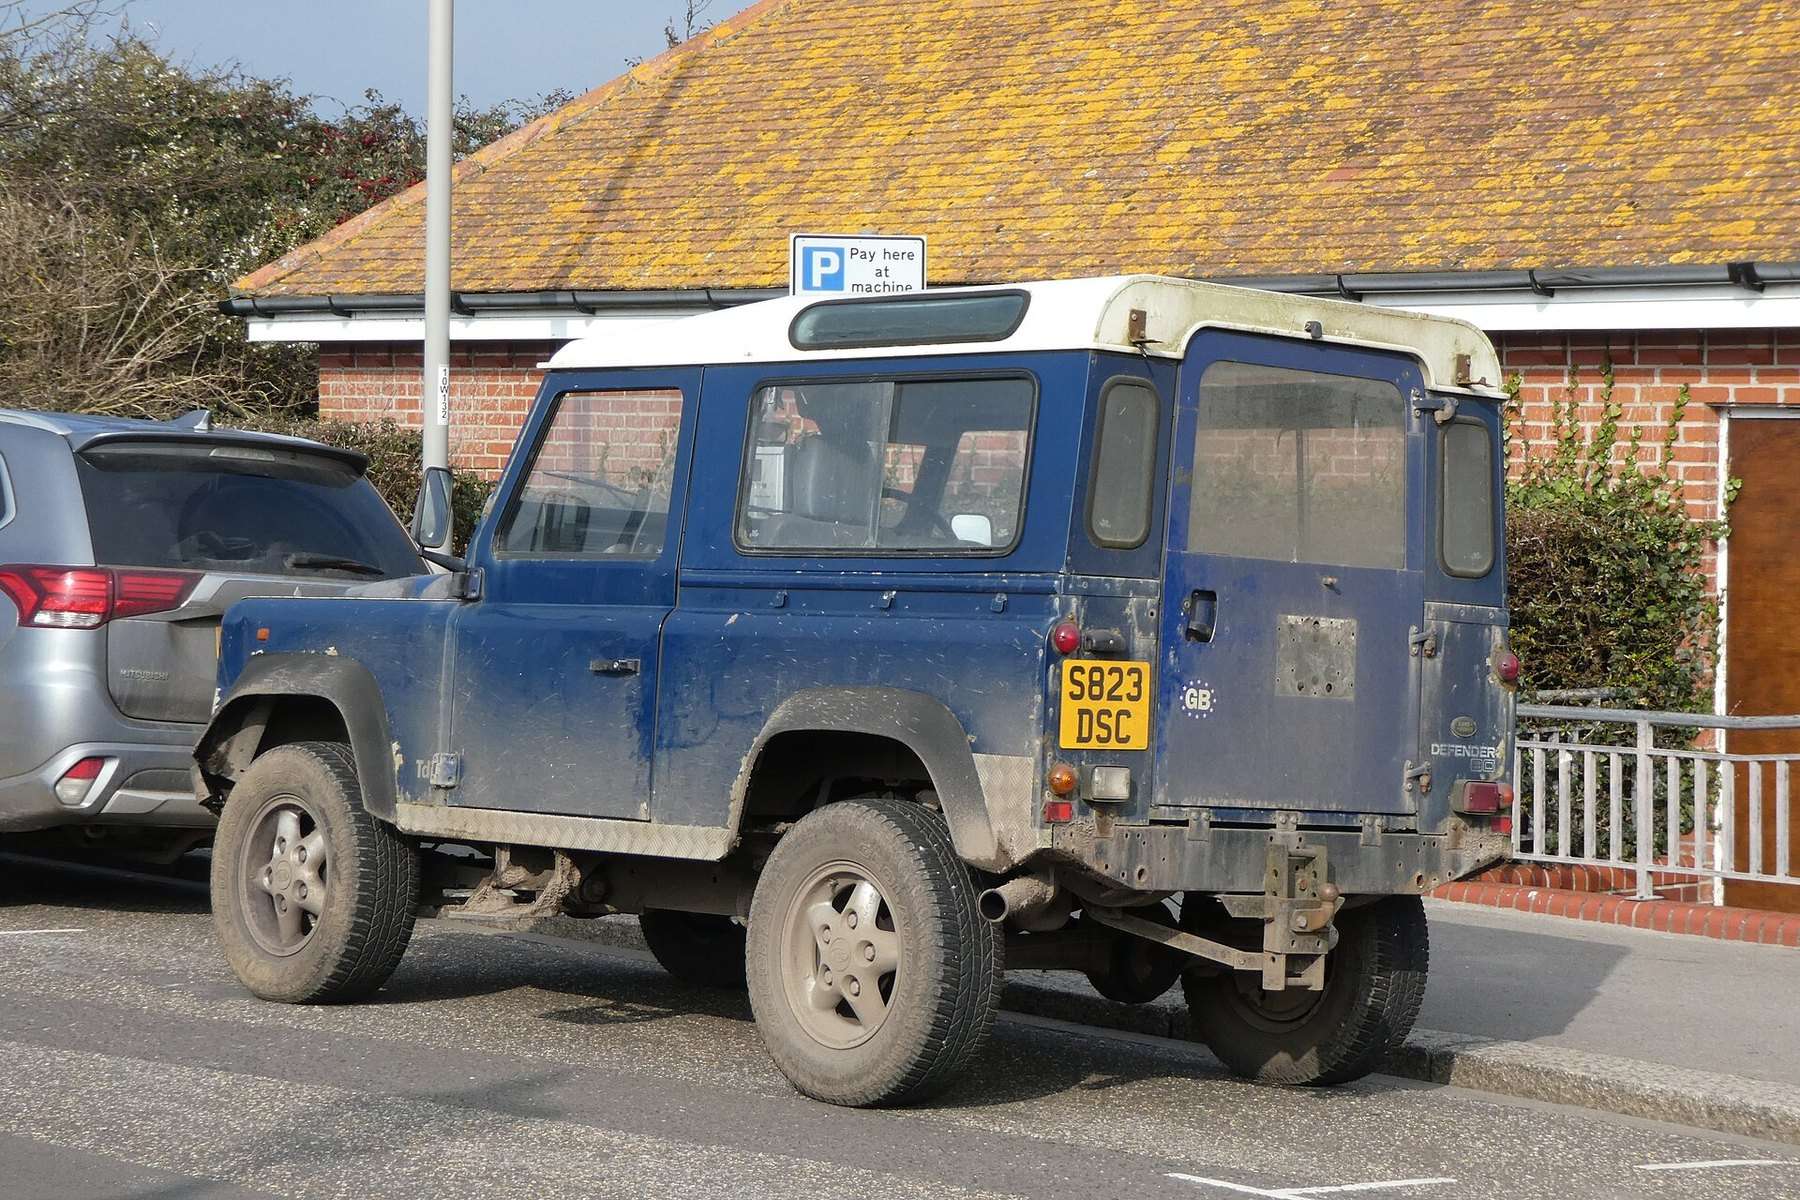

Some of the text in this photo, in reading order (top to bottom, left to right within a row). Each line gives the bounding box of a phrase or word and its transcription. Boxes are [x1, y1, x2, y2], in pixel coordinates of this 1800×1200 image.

[850, 247, 915, 262] Pay here
[812, 250, 840, 288] P
[875, 266, 890, 278] at
[851, 281, 913, 293] machine
[439, 367, 449, 419] 10W132
[1069, 665, 1143, 701] S823
[1185, 687, 1211, 710] GB
[1076, 708, 1132, 744] DSC
[1431, 743, 1496, 758] DEFENDER
